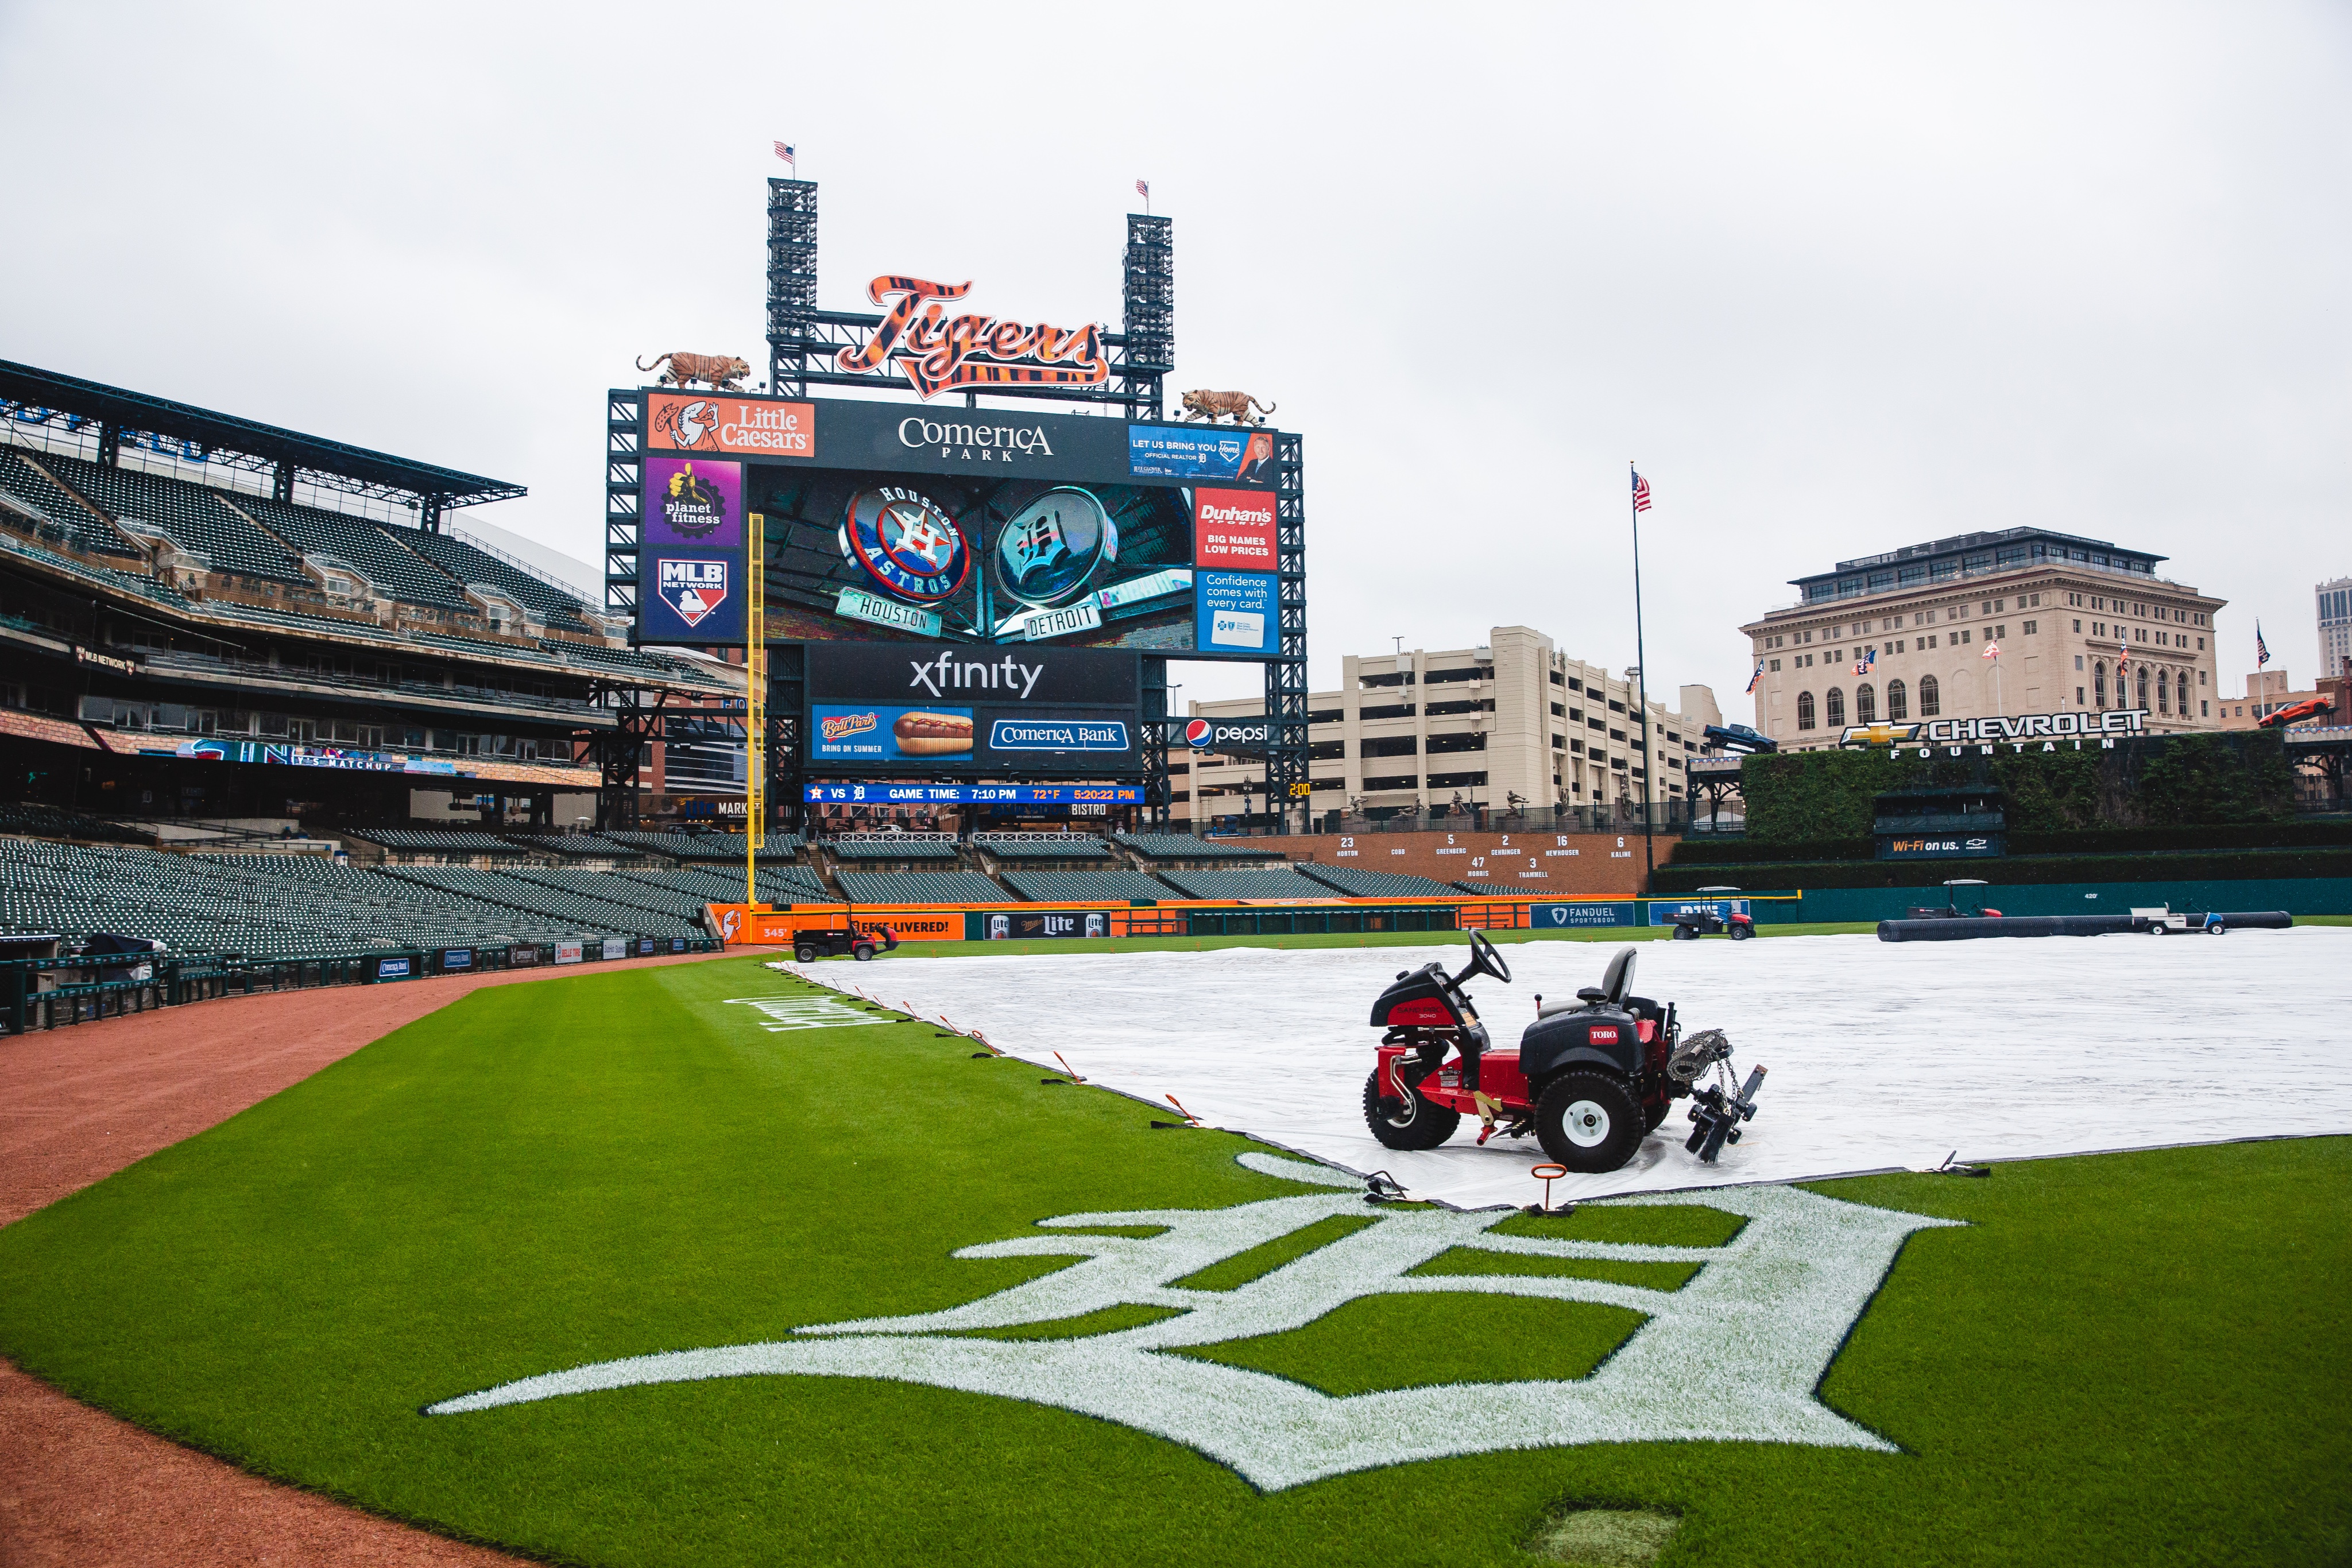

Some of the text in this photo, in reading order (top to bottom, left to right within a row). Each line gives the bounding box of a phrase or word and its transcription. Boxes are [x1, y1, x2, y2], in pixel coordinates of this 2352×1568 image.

[836, 273, 1109, 396] Tigers
[739, 405, 798, 431] Little
[721, 423, 806, 450] Caesars
[1132, 440, 1240, 454] LET US BRING YOU Home
[942, 447, 1013, 462] PARK
[666, 501, 711, 514] planet
[879, 487, 960, 537] HOUSTON
[1201, 505, 1272, 522] Dunham's
[672, 512, 720, 524] fitness
[1208, 535, 1266, 545] BIG NAMES
[1205, 545, 1268, 556] LOW PRICES
[663, 563, 723, 582] MLB
[865, 547, 951, 593] ASTROS
[1206, 574, 1267, 587] Confidence
[1207, 588, 1267, 598] comes with
[1207, 599, 1264, 610] every card.
[860, 598, 927, 629] HOUSTON
[1030, 605, 1092, 637] DETROIT
[98, 655, 126, 670] NETWORK
[910, 651, 1043, 699] xfinity
[1928, 708, 2150, 741] CHEVROLET
[1078, 727, 1117, 741] Bank
[1216, 725, 1268, 743] pepsi
[822, 744, 841, 752] BRING
[1890, 738, 2114, 759] FOUNTAIN
[328, 759, 391, 771] MATCHUP
[830, 788, 846, 799] VS
[889, 789, 923, 799] GAME
[929, 789, 960, 799] TIME:
[972, 789, 996, 799] 7:10
[999, 789, 1016, 799] PM
[1074, 790, 1113, 799] 5:20:22
[1118, 790, 1135, 800] PM
[1290, 783, 1310, 795] 2:00
[685, 800, 761, 819] Lite MARKT
[1071, 804, 1106, 815] BISTRO
[1341, 837, 1354, 847] 23
[1448, 834, 1454, 845] 5
[1502, 835, 1509, 846] 2
[1556, 835, 1568, 846] 16
[1617, 837, 1624, 847] 6
[1893, 840, 1959, 851] Wi-Fi on us.
[1472, 857, 1484, 868] 47
[1529, 858, 1537, 868] 3
[1569, 908, 1615, 917] FANDUEL
[993, 920, 1008, 930] Lite
[1021, 916, 1074, 935] Miller Lite
[1088, 918, 1102, 928] Lite
[764, 928, 787, 937] 345'
[562, 948, 572, 958] BELLE
[1591, 1031, 1616, 1039] TORO
